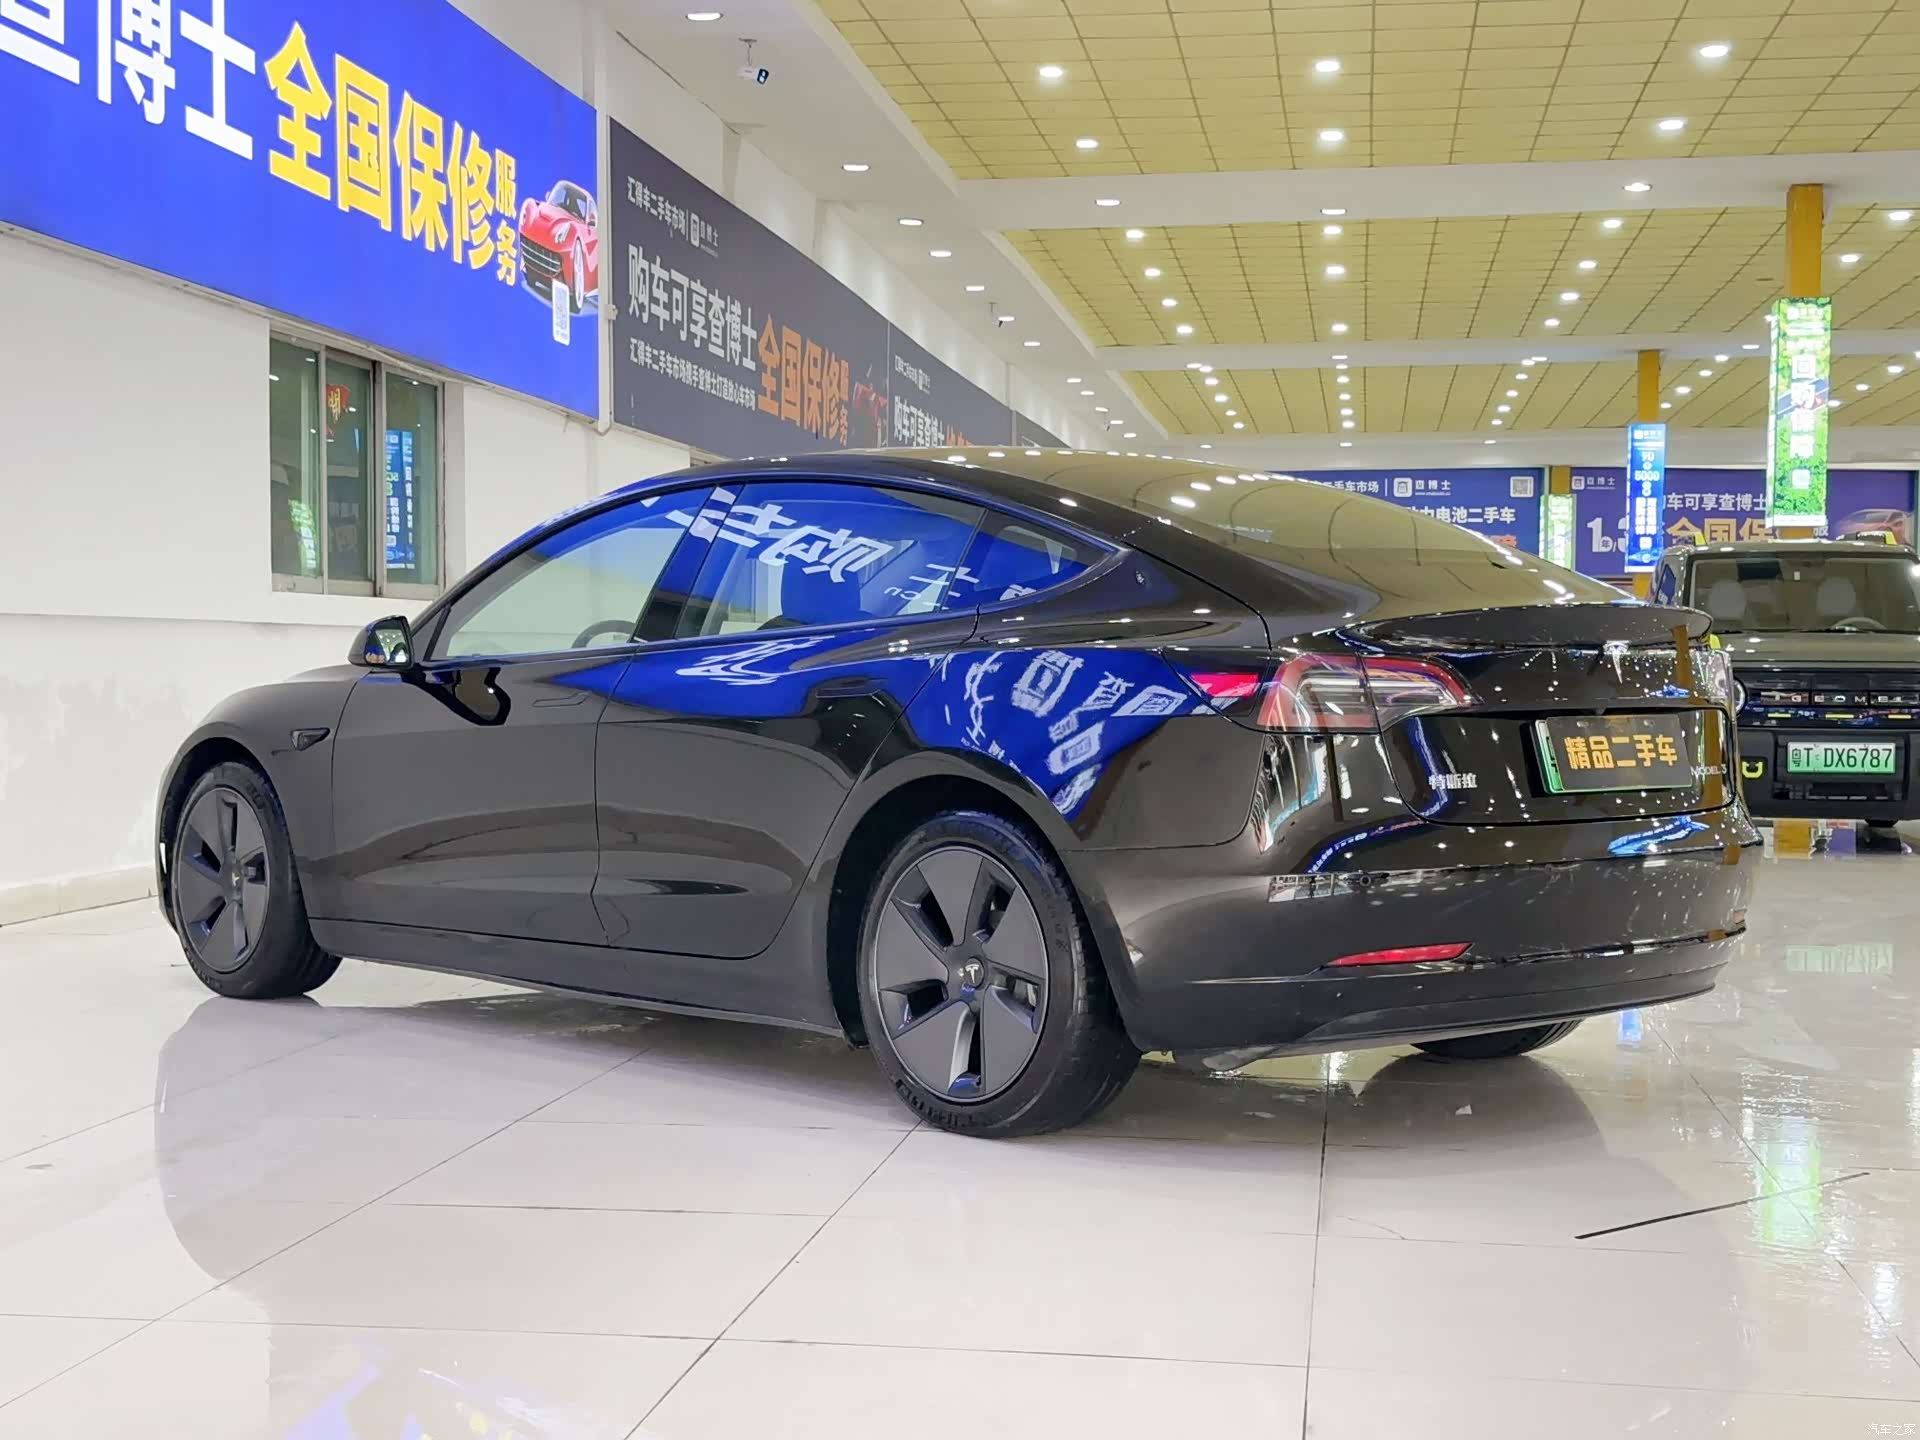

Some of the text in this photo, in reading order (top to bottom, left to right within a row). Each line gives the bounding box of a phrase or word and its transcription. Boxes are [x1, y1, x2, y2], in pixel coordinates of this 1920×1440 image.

[265, 20, 494, 270] 全国保修
[494, 148, 518, 287] 服务
[627, 243, 840, 441] 购车可享查博士 全国保修
[1634, 470, 1660, 481] 5000
[1314, 479, 1379, 493] 手车市场
[1662, 492, 1767, 512] 车可享查博士
[1564, 733, 1678, 770] 精品二手车
[1823, 748, 1893, 768] DX6787
[1690, 763, 1728, 777] MODEL 3
